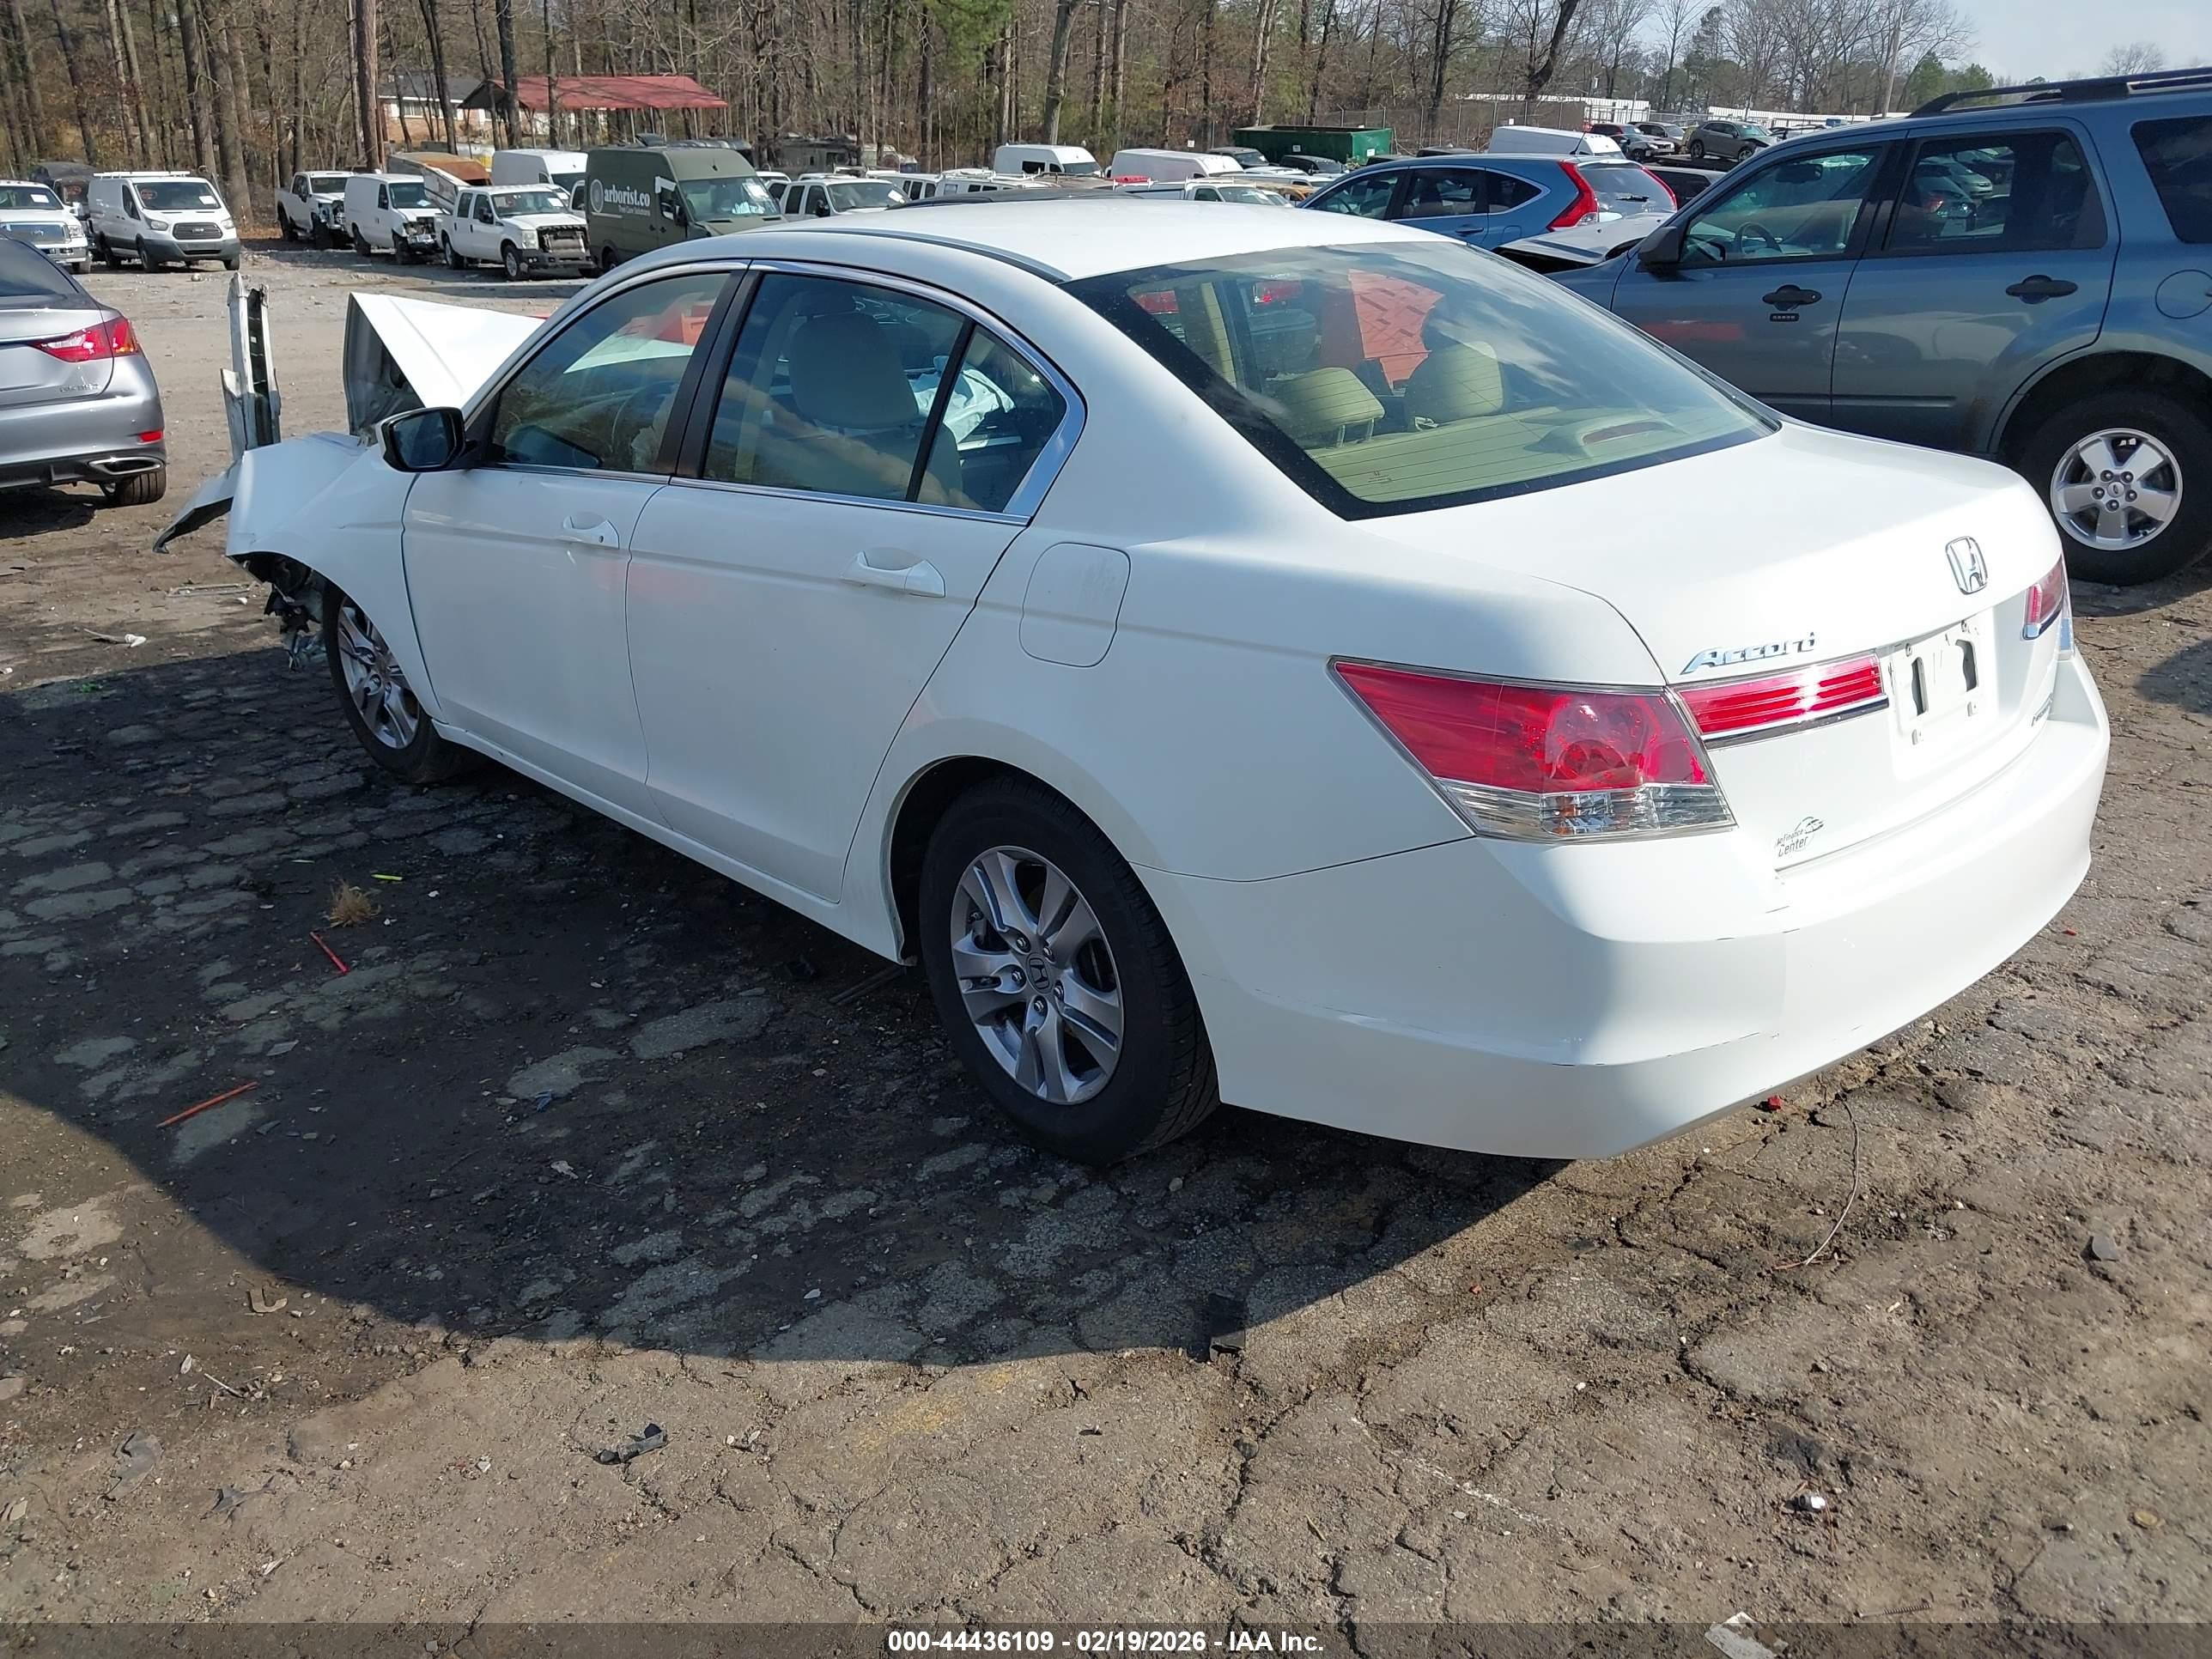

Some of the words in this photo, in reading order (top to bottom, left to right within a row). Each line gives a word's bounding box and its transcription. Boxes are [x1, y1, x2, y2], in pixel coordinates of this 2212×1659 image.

[604, 184, 650, 206] arborist.co
[1680, 631, 1815, 675] Accord
[1778, 836, 1808, 857] Center
